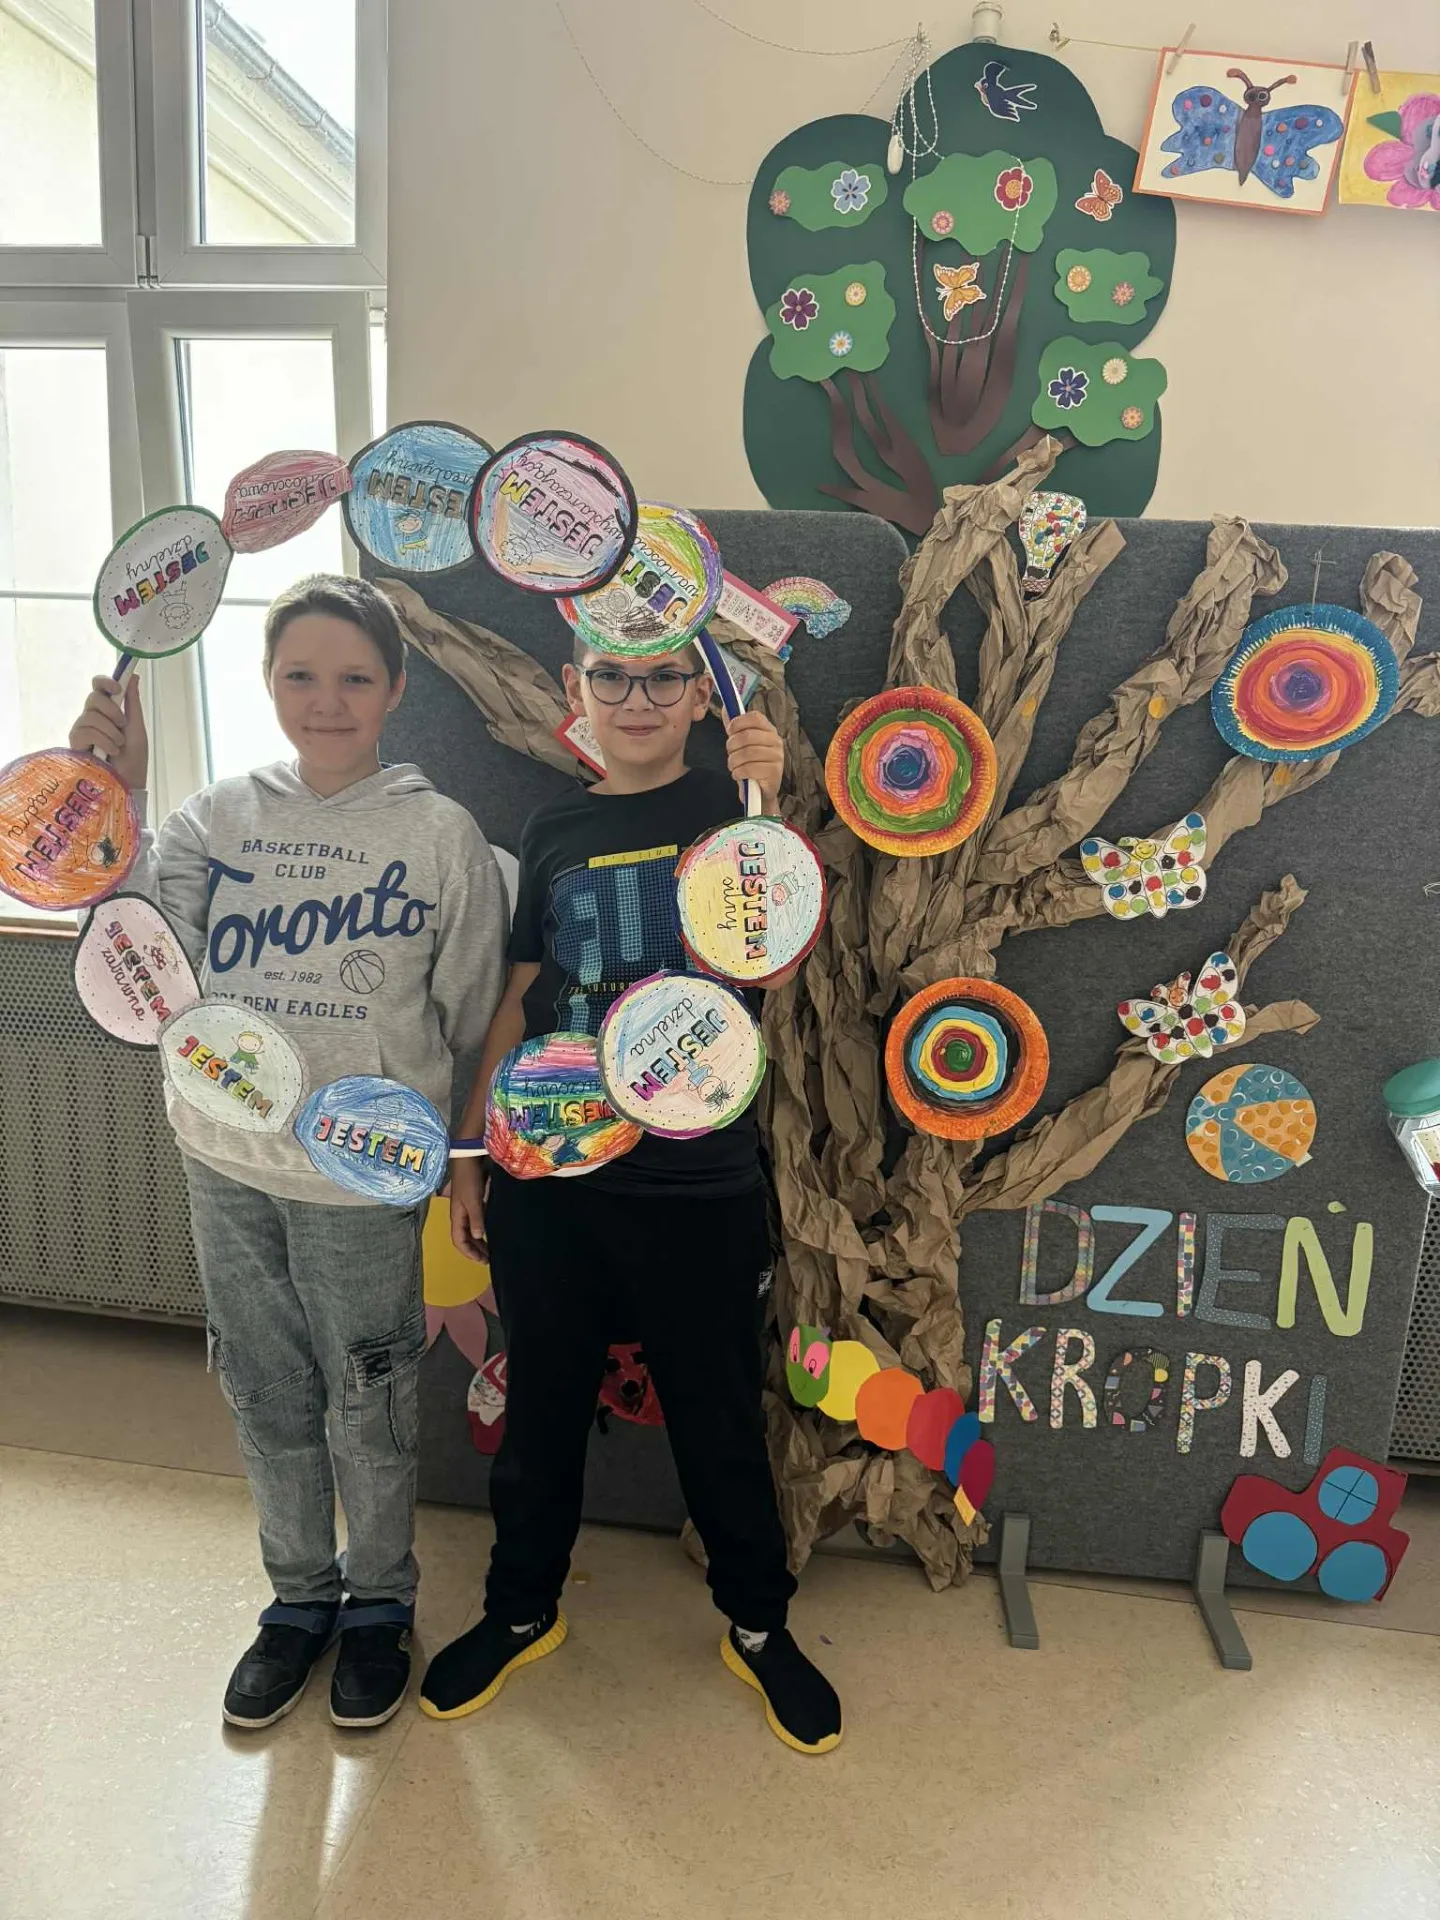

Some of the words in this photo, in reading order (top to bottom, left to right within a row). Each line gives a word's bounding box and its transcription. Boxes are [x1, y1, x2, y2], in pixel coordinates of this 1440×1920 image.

[368, 469, 470, 521] ESTEM
[386, 451, 474, 486] reatywny
[500, 471, 603, 560] JESTEM
[114, 541, 210, 616] JESTEM
[126, 535, 192, 580] dzielny
[618, 552, 687, 623] JEST
[8, 778, 59, 839] mądra
[15, 779, 103, 881] JESTEM
[241, 839, 369, 865] BASKETBALL
[275, 863, 326, 879] CLUB
[208, 857, 437, 973] Toronto
[717, 877, 745, 931] silny
[739, 842, 767, 960] JESTEM
[101, 947, 144, 1021] zabawna
[105, 921, 172, 1022] JESTEM
[264, 970, 286, 981] est.
[291, 971, 323, 985] 1982
[286, 1000, 368, 1021] EAGLES
[630, 997, 697, 1056] dzielna
[177, 1035, 273, 1119] JESTEM
[630, 1009, 728, 1101] JESTEM
[316, 1116, 425, 1174] JESTEM
[1020, 1200, 1373, 1336] DZIEŃ
[978, 1318, 1327, 1466] KROPKI
